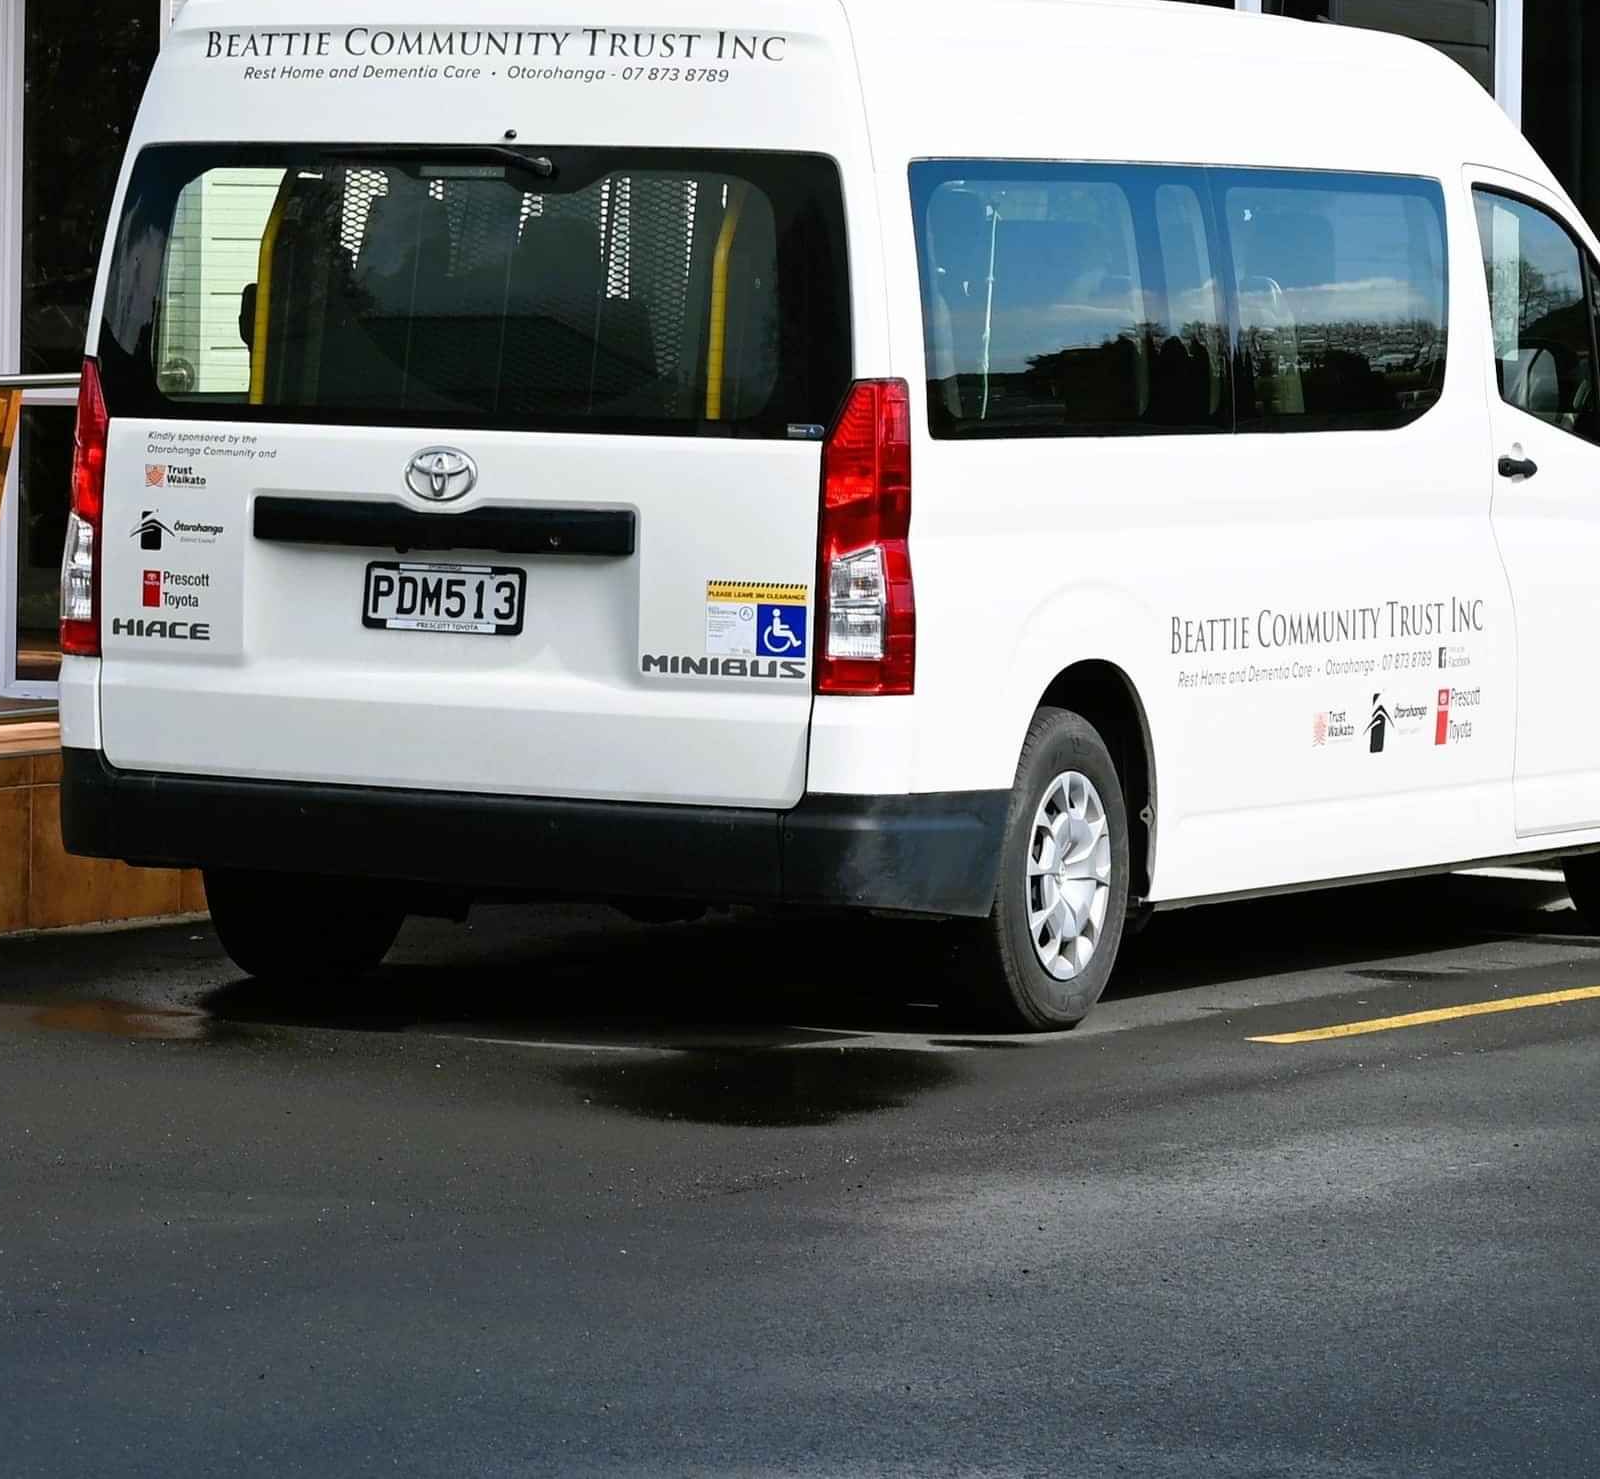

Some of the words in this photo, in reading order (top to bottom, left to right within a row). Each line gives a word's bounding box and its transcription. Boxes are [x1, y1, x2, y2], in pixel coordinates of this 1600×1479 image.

[205, 30, 331, 58] BEATTIE
[344, 27, 572, 57] COMMUNITY
[582, 28, 702, 58] TRUST
[716, 31, 787, 61] INC
[243, 66, 276, 80] Rest
[280, 65, 324, 79] Home
[329, 65, 359, 79] and
[363, 65, 438, 80] Dementia
[443, 65, 481, 79] Care
[507, 65, 605, 83] Otorohanga
[622, 67, 644, 81] 07
[648, 67, 680, 82] 873
[685, 67, 729, 83] 8789
[148, 431, 176, 442] Kindly
[178, 432, 225, 443] sponsored
[228, 433, 239, 444] by
[242, 434, 257, 444] the
[203, 446, 256, 459] Community
[258, 450, 277, 458] and
[167, 465, 193, 475] Trust
[167, 475, 207, 486] Waikato
[163, 570, 210, 587] Prescott
[162, 591, 199, 609] Toyota
[372, 575, 516, 620] PDM513
[112, 617, 211, 640] HIACE
[452, 623, 479, 631] TOYOTA
[1171, 616, 1249, 654] BEATTIE
[1257, 608, 1381, 648] COMMUNITY
[1386, 601, 1445, 638] TRUST
[1451, 596, 1484, 633] INC
[642, 654, 806, 679] MINIBUS
[1178, 670, 1199, 688] Rest
[1292, 661, 1313, 678] Care
